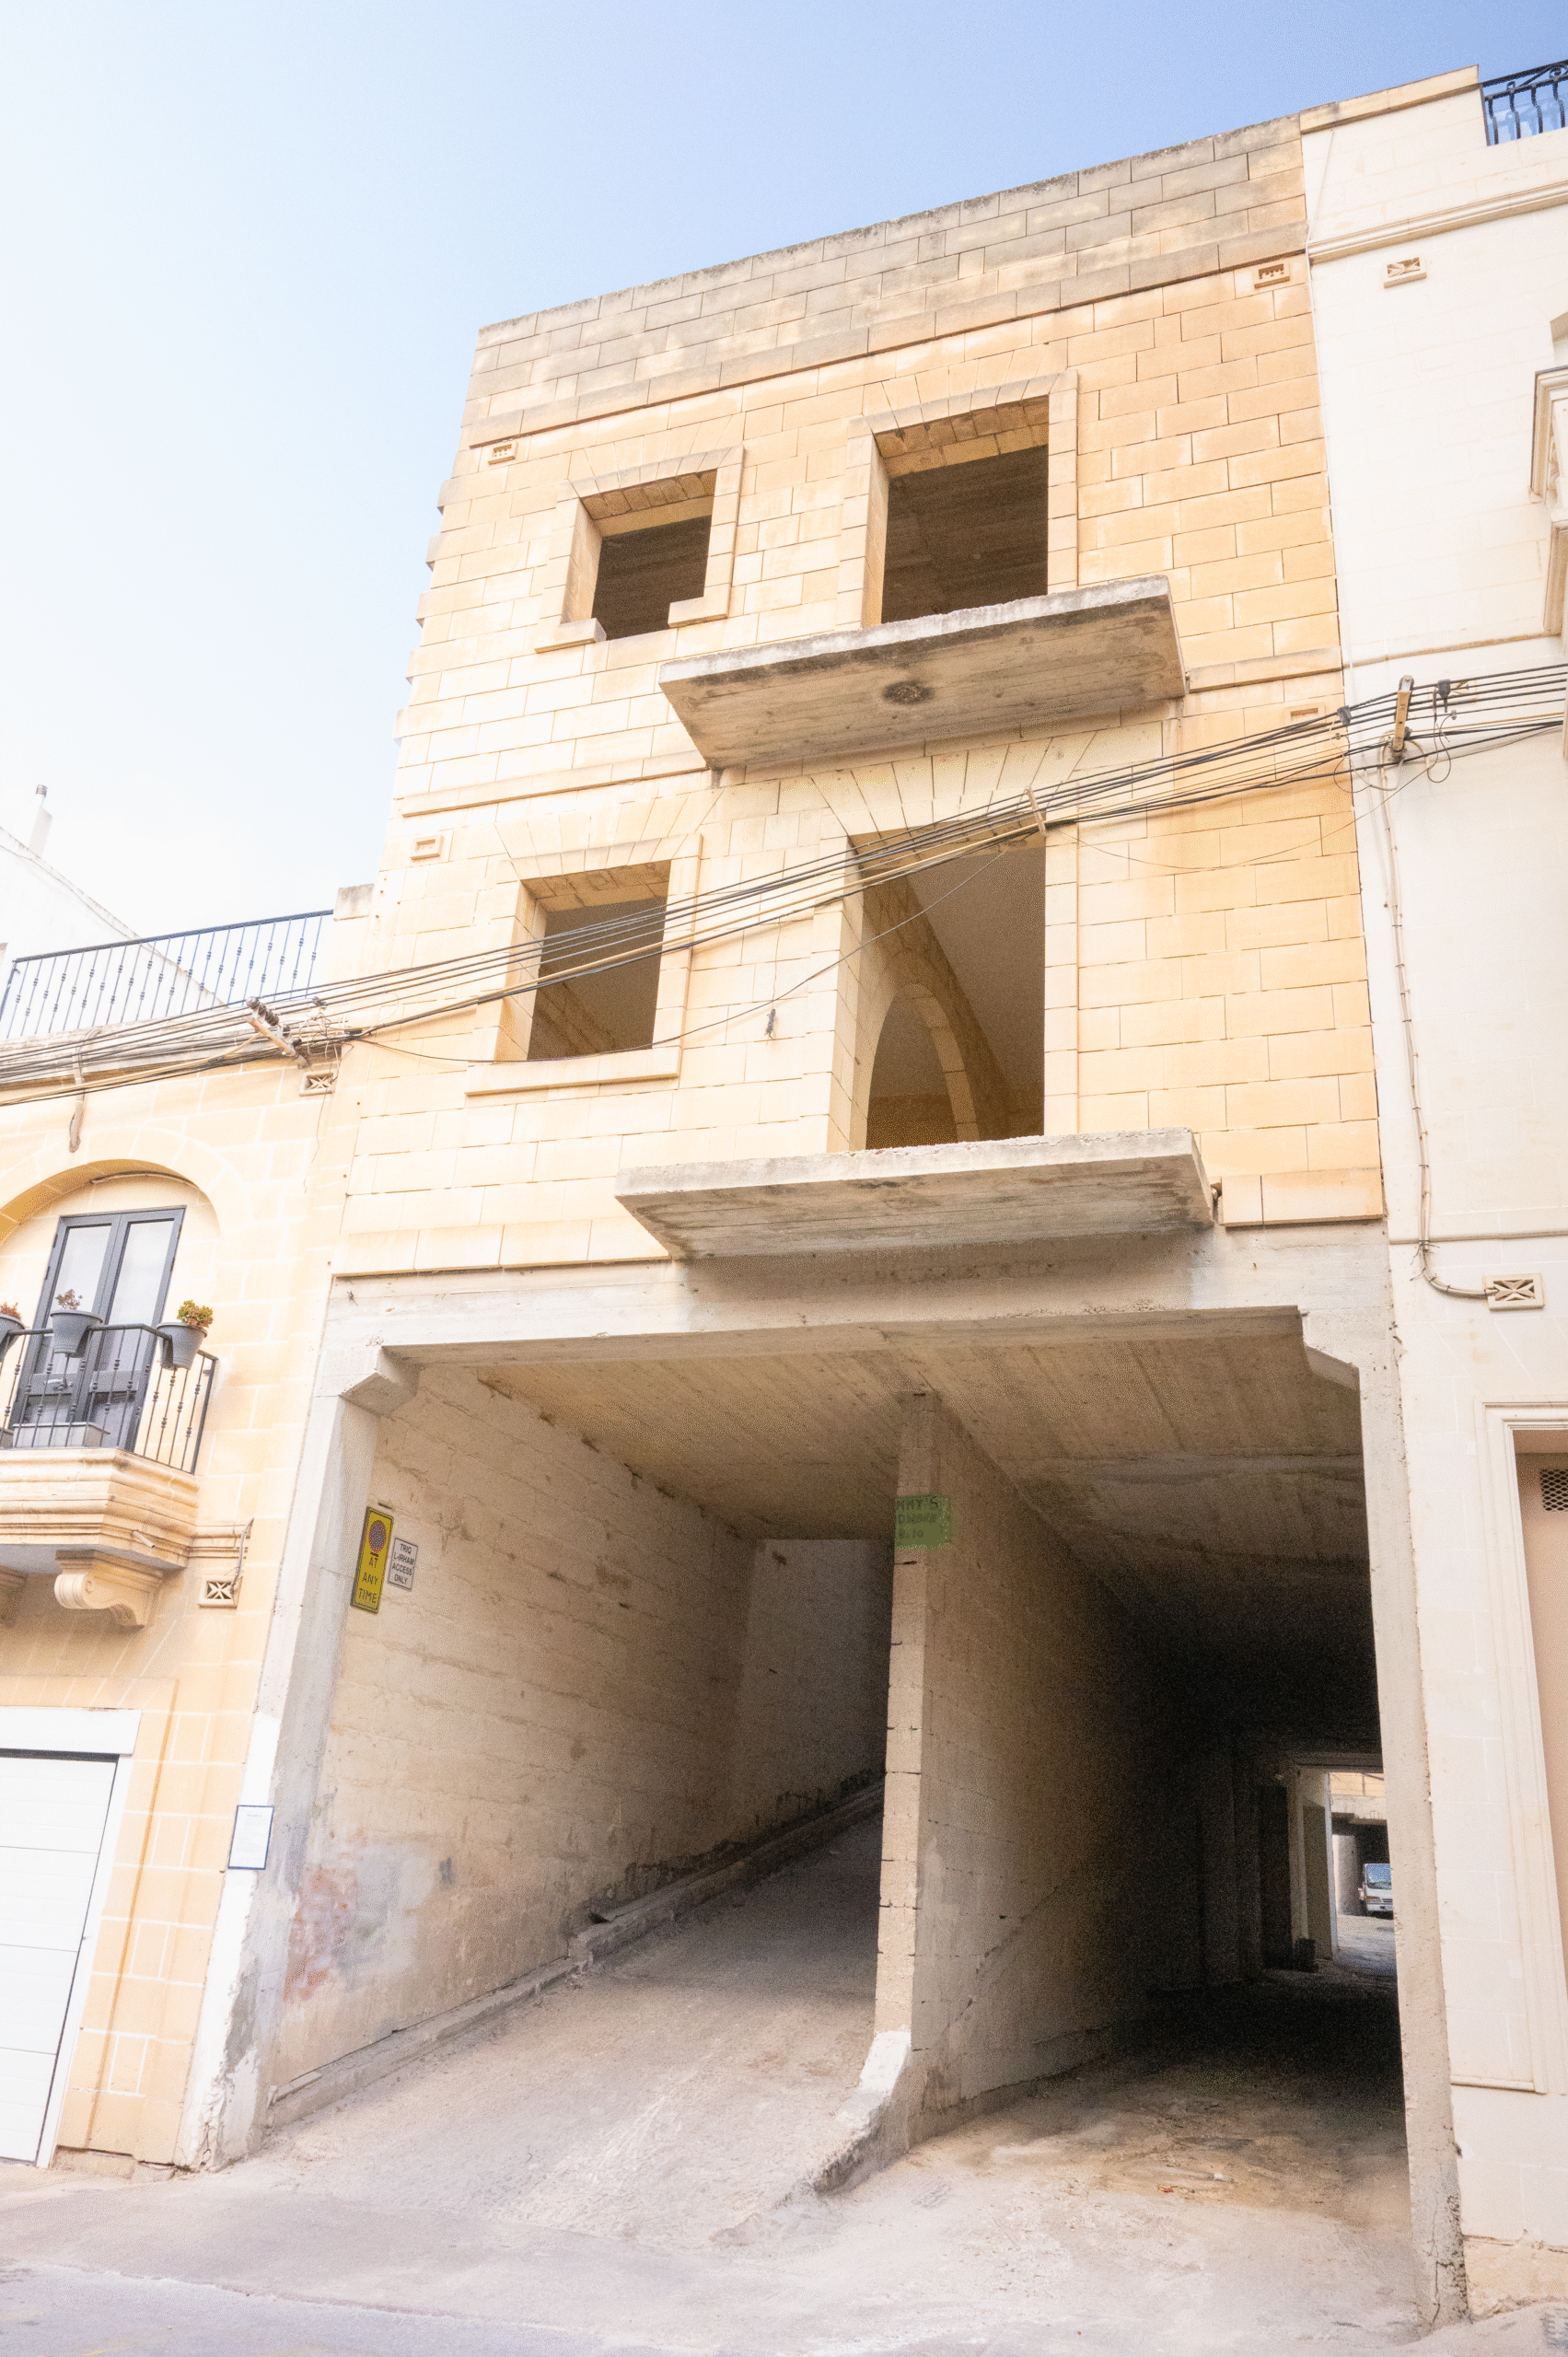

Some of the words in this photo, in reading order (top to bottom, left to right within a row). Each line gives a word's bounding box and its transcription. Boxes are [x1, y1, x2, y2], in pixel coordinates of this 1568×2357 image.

[400, 1543, 412, 1554] TRIQ
[368, 1556, 378, 1568] AT
[391, 1562, 412, 1576] ACCESS
[362, 1572, 378, 1585] ANY
[394, 1573, 408, 1584] ONLY
[358, 1587, 377, 1604] TIME
